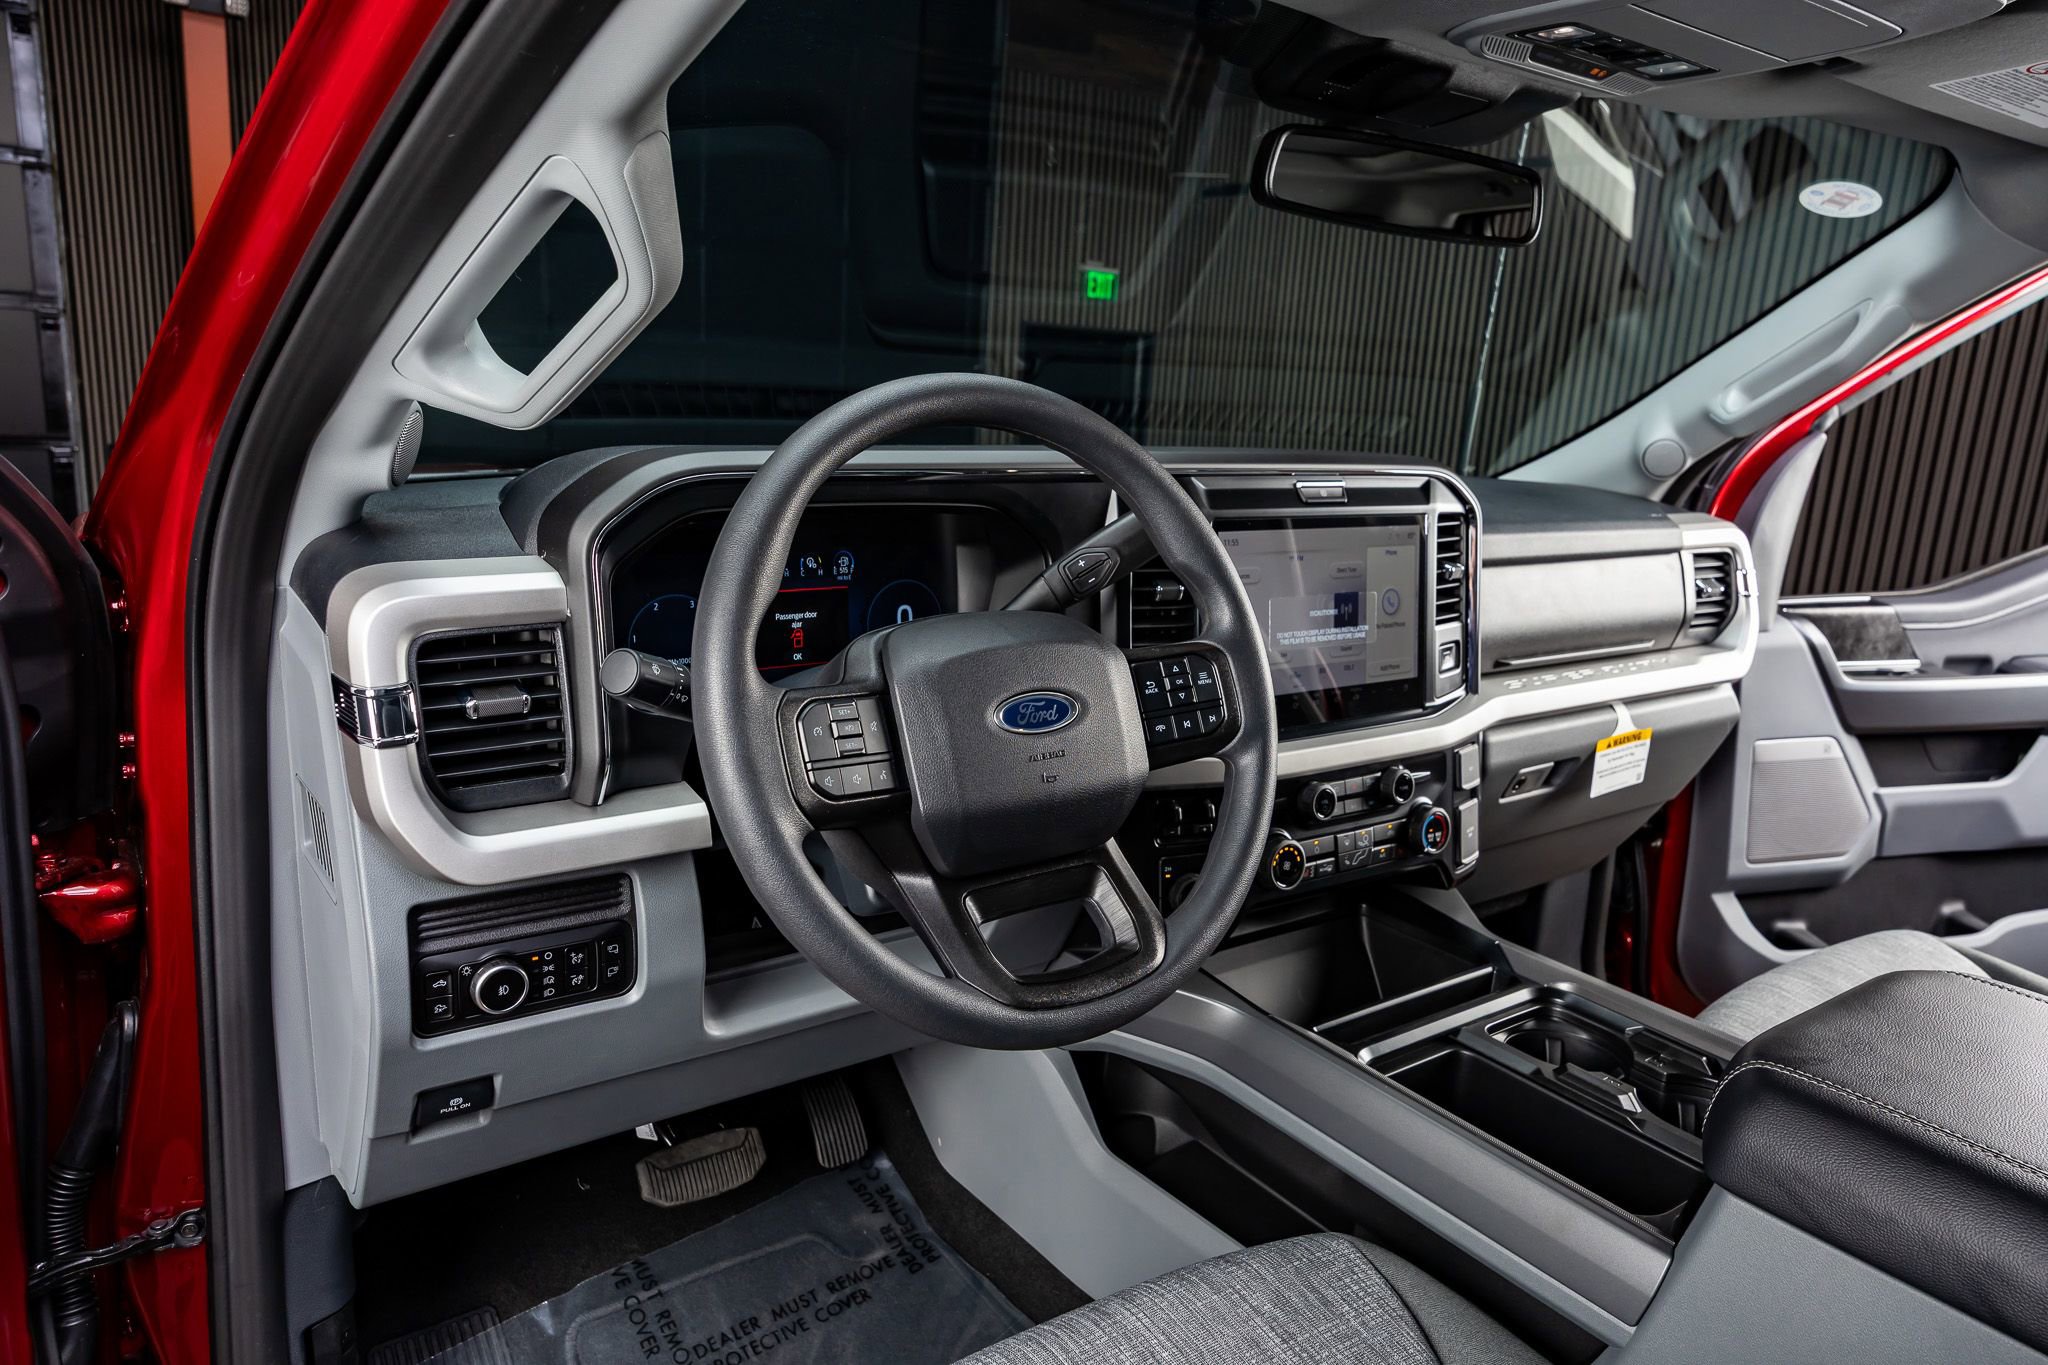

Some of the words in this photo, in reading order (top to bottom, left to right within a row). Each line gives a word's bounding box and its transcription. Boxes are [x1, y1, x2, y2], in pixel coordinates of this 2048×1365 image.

[653, 602, 660, 611] 2
[689, 600, 695, 609] 3
[775, 613, 804, 621] Passenger
[791, 621, 803, 629] ajar
[793, 653, 803, 661] OK
[1144, 687, 1159, 695] BACK
[1017, 700, 1059, 725] Ford
[1613, 732, 1642, 747] WARNING
[440, 1105, 459, 1115] PULL
[847, 1178, 884, 1214] MUST
[692, 1315, 762, 1360] DEALER
[771, 1288, 820, 1322] MUST
[825, 1254, 896, 1295] REMOVE
[814, 1287, 873, 1324] COVER
[623, 1294, 661, 1360] COVER
[655, 1308, 694, 1365] REMO
